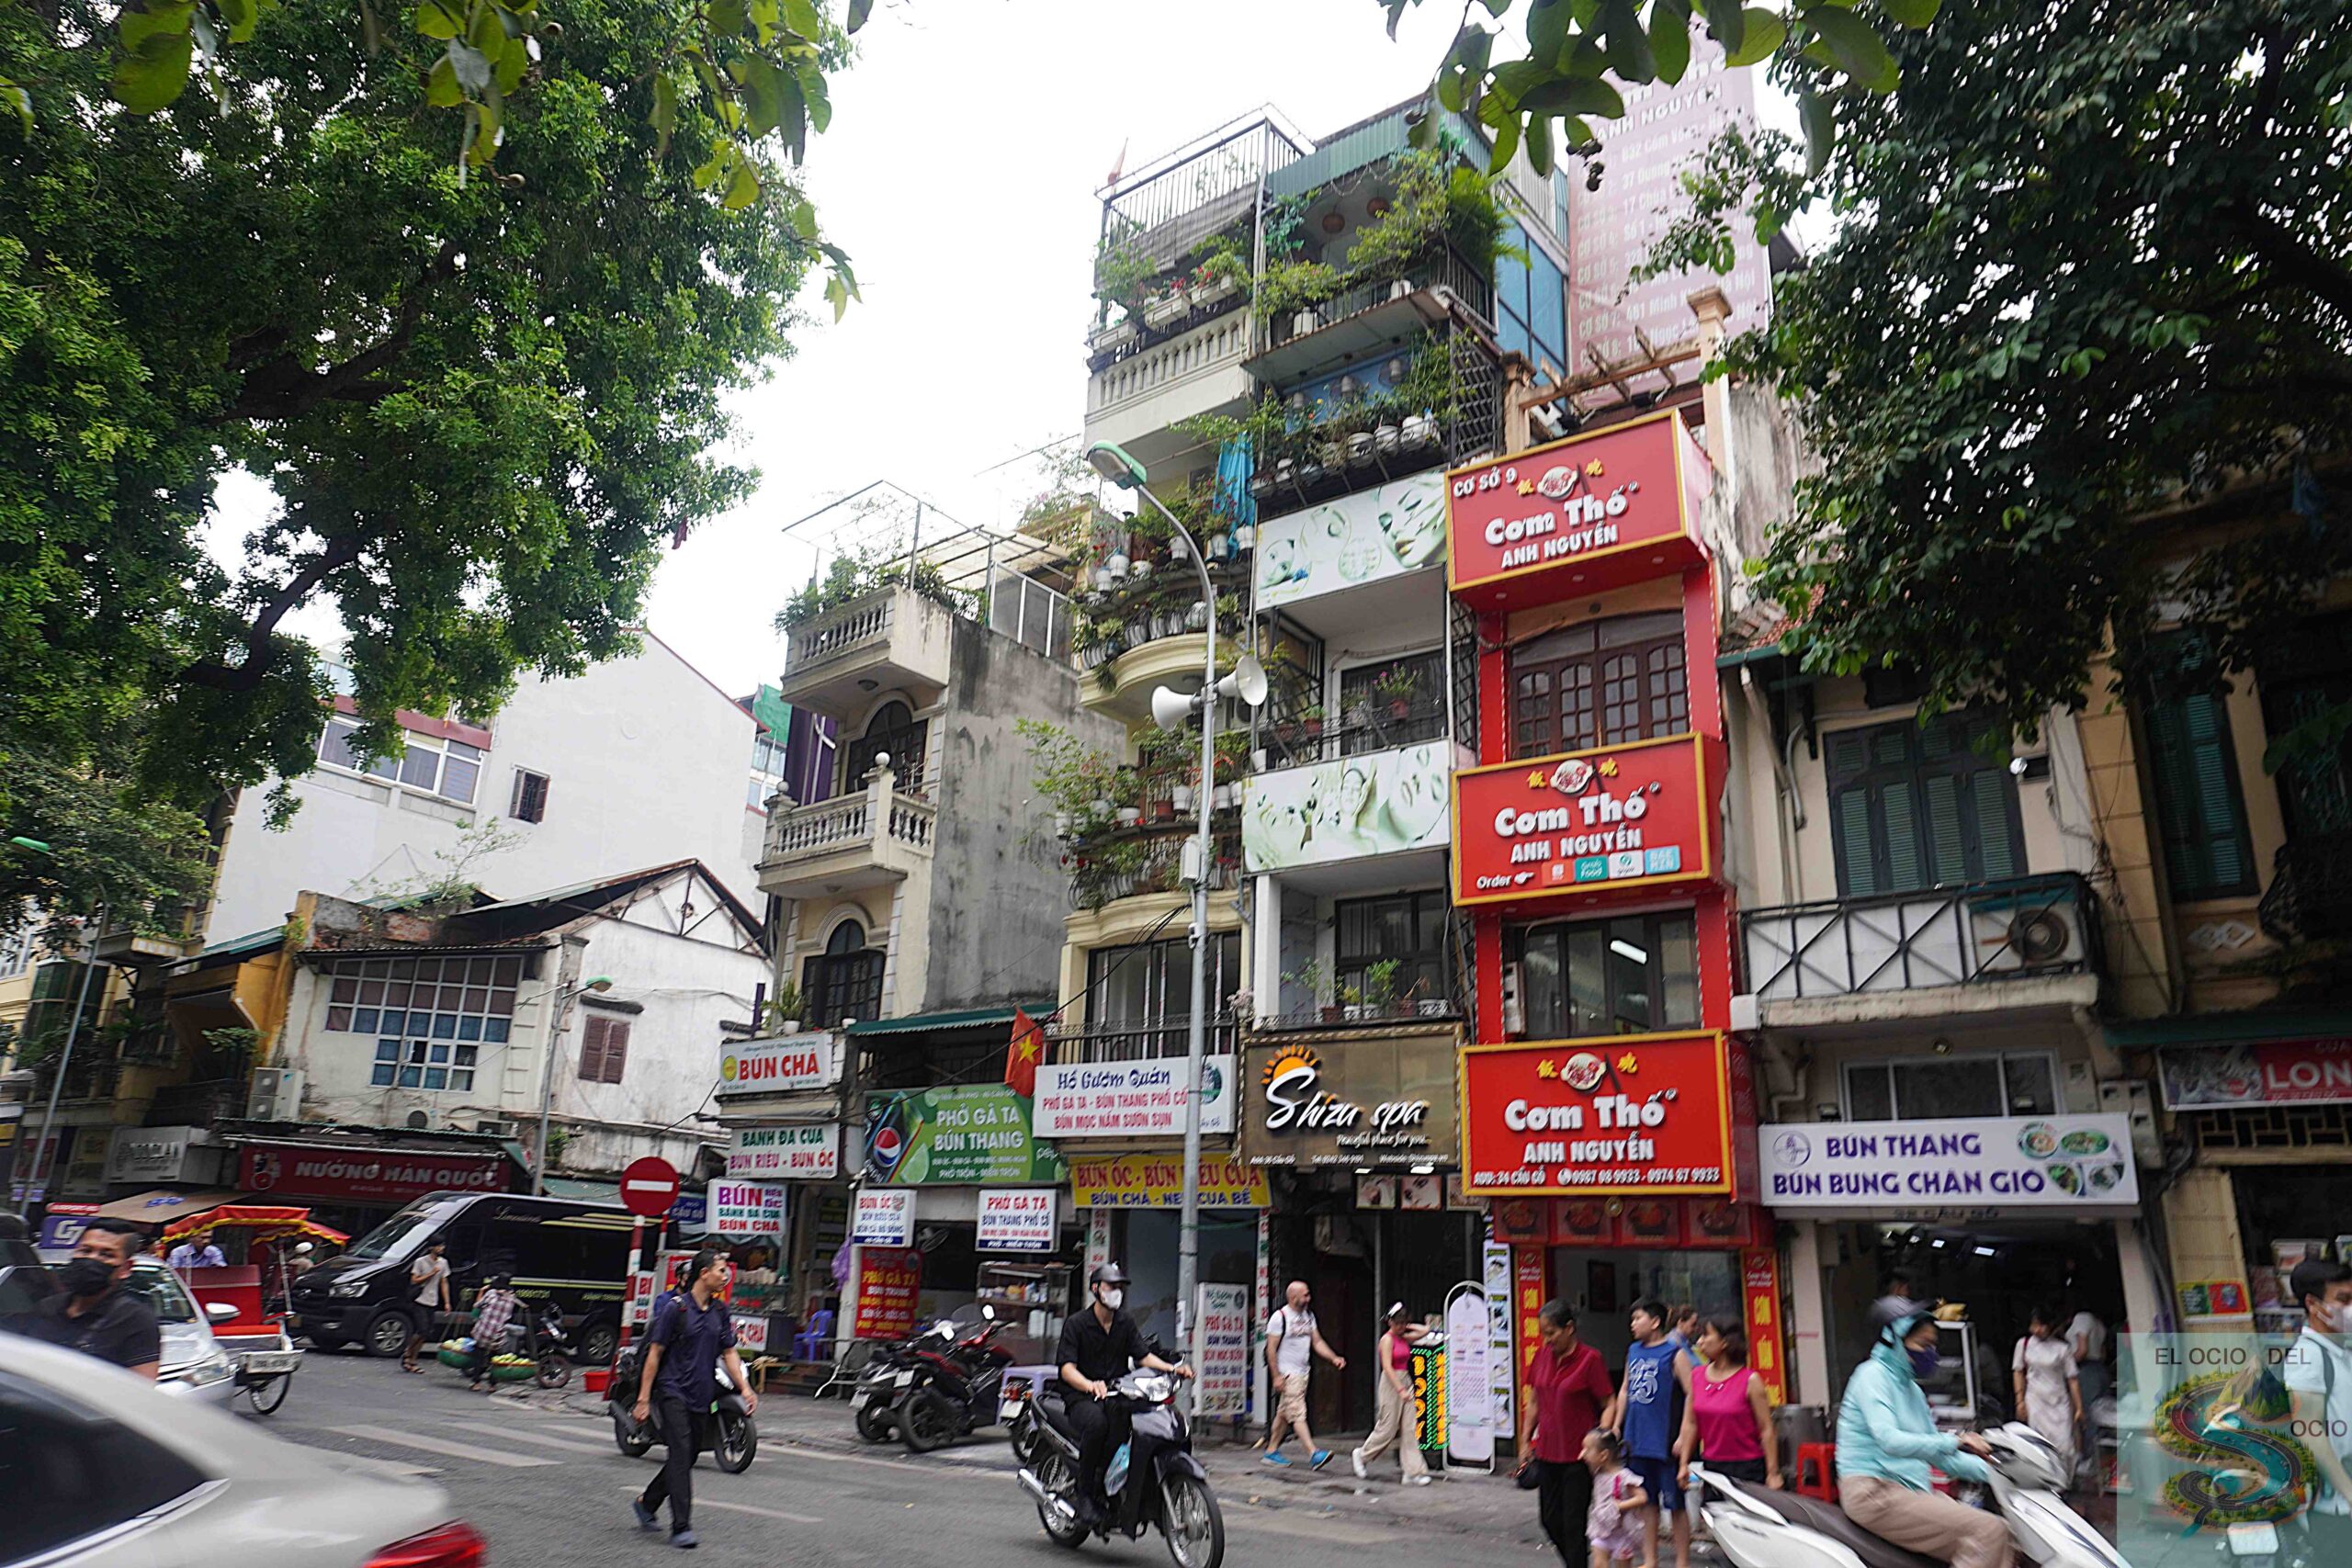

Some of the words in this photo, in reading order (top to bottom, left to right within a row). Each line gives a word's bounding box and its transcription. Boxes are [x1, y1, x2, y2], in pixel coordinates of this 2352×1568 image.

[1453, 477, 1476, 498] CƠ
[1478, 466, 1501, 490] SỞ
[1505, 466, 1517, 484] 9
[1485, 511, 1555, 545] Cơm
[1564, 485, 1629, 526] Thố
[1501, 543, 1540, 569] ANH
[1494, 806, 1570, 838] Cơm
[1578, 785, 1647, 826] Thố
[1510, 839, 1552, 864] ANH
[1476, 874, 1512, 890] Order
[739, 1053, 777, 1081] BÚN
[781, 1047, 820, 1077] CHẢ
[1081, 1070, 1125, 1090] Gươm
[1129, 1066, 1170, 1090] Quán
[1077, 1095, 1088, 1110] TA
[1095, 1091, 1115, 1110] BÚN
[1117, 1093, 1149, 1110] THANG
[1265, 1066, 1362, 1130] Shizu
[1370, 1100, 1430, 1134] spa
[1504, 1099, 1583, 1132] Cơm
[1593, 1090, 1666, 1129] Thố
[936, 1102, 970, 1128] PHỞ
[1001, 1105, 1022, 1124] TA
[1054, 1111, 1073, 1130] BÚN
[800, 1127, 825, 1145] CUA
[934, 1129, 965, 1152] BÚN
[968, 1131, 1025, 1151] THANG
[1826, 1132, 1877, 1158] BÚN
[1883, 1134, 1982, 1158] THANG
[729, 1150, 752, 1171] BÚN
[790, 1148, 816, 1169] BÚN
[818, 1144, 835, 1168] ỐC
[1522, 1141, 1566, 1165] ANH
[294, 1157, 381, 1179] NƯỚNG
[1077, 1163, 1109, 1189] BÚN
[1111, 1156, 1133, 1189] ỐC
[1144, 1159, 1177, 1189] BÚN
[1224, 1161, 1263, 1188] CUA
[718, 1184, 763, 1206] BÚN
[1773, 1170, 1822, 1195] BÚN
[1829, 1172, 1901, 1195] BUNG
[987, 1191, 1012, 1211] PHỞ
[1032, 1196, 1047, 1211] TA
[1090, 1188, 1119, 1206] BÚN
[1121, 1187, 1152, 1205] CHẢ
[1162, 1191, 1185, 1206] NE
[1196, 1191, 1228, 1206] CUA
[718, 1219, 748, 1231] BÚN
